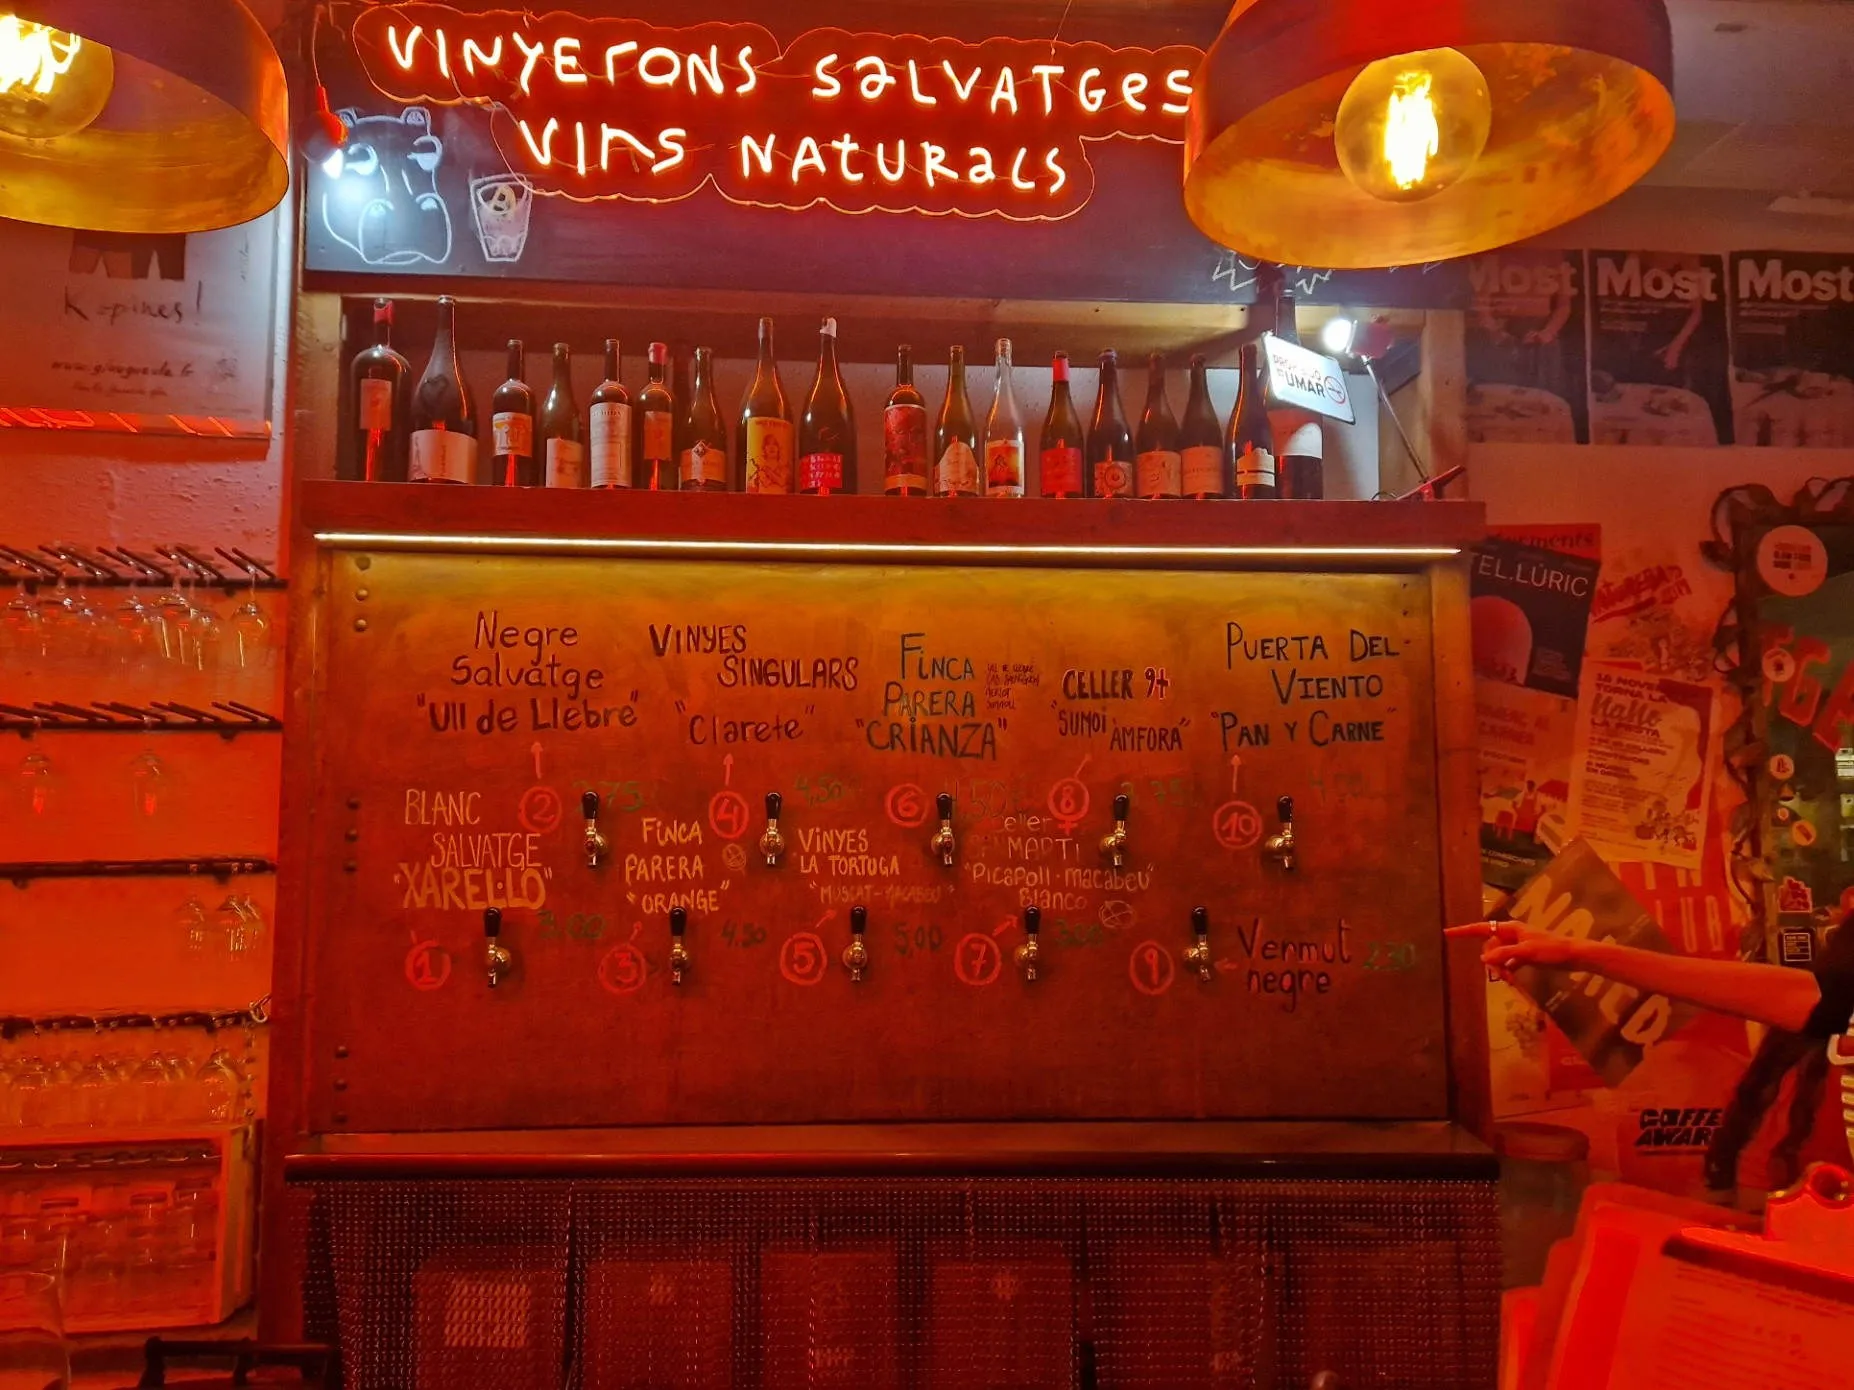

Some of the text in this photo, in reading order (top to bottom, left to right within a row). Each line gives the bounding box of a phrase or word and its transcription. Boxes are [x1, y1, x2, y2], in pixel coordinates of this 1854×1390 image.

[1597, 254, 1718, 301] Most
[1737, 258, 1854, 302] Most
[474, 608, 579, 667] Negre
[648, 623, 747, 658] VINYES
[1226, 621, 1400, 670] PUERTA DEL
[450, 651, 605, 700] Salvatge
[716, 653, 859, 692] SINGULARS
[1061, 667, 1134, 701] CELLER
[1270, 667, 1385, 706] VIENTO
[475, 697, 519, 736] de
[883, 680, 976, 718] PARERA
[1284, 720, 1299, 742] Y
[404, 787, 482, 826] BLANC
[430, 831, 543, 871] SALVATGE
[624, 853, 704, 886] PARERA
[799, 854, 901, 878] LA TORTUGA
[1237, 916, 1353, 965] Vermut
[1247, 967, 1332, 1015] negre
[1633, 1126, 1714, 1148] AWAR
[1639, 1107, 1724, 1130] COFFE
